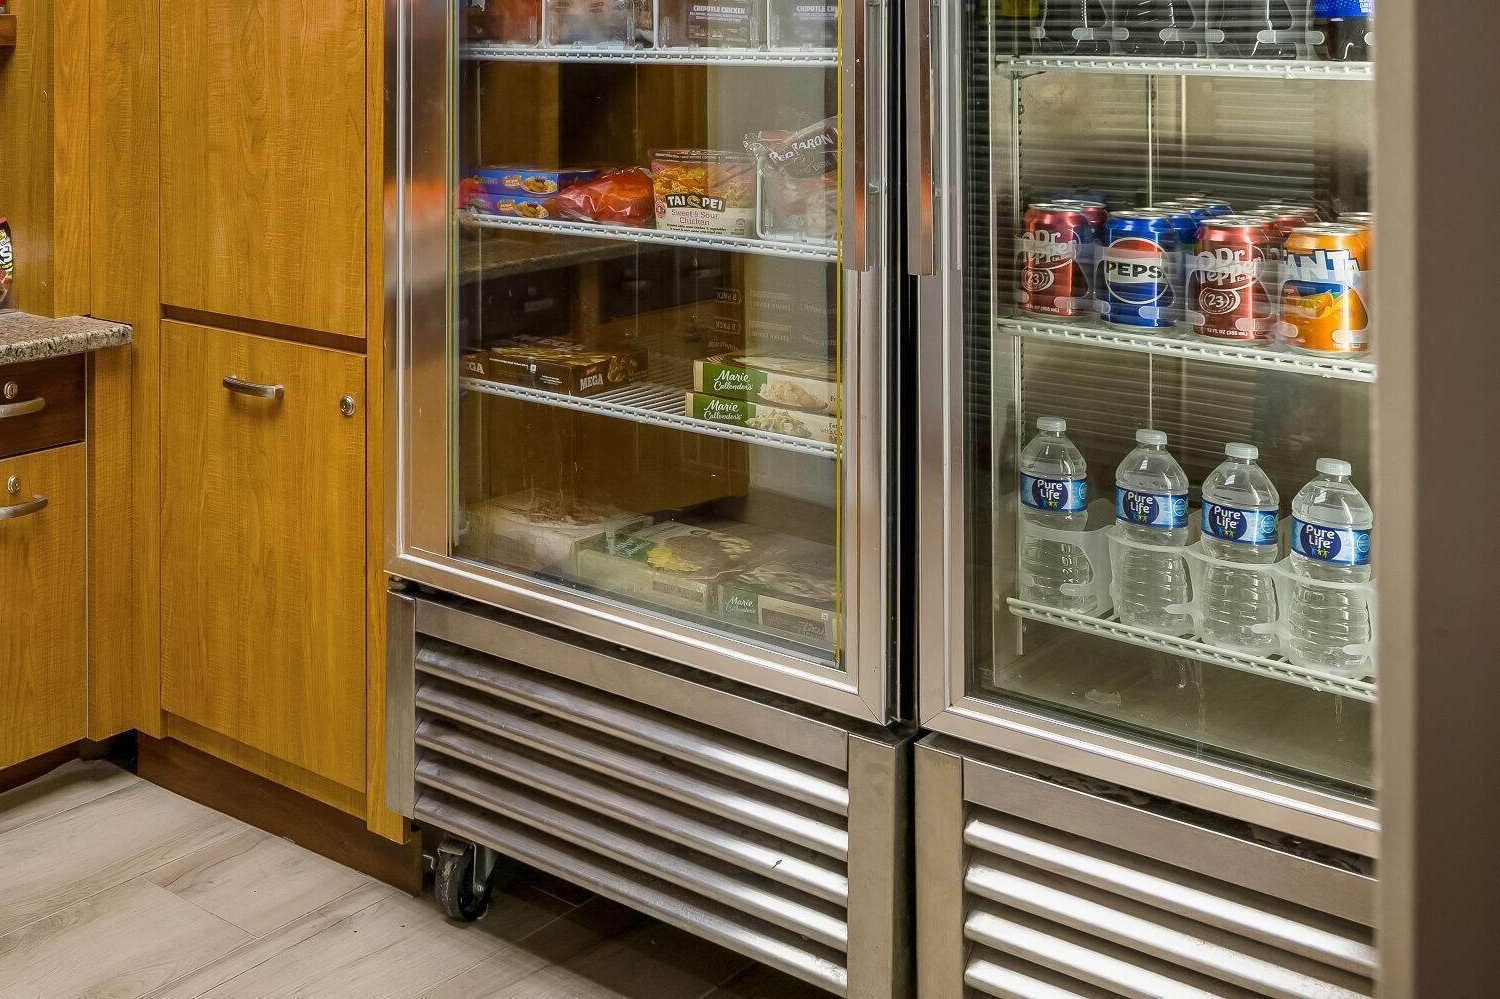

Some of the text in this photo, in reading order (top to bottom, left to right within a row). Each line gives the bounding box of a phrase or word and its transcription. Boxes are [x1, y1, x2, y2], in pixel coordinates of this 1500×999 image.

[693, 5, 746, 14] CHIPOTLE CHICKEN
[796, 5, 824, 13] CHIPOTLE
[768, 133, 834, 164] RED BARON
[667, 195, 723, 210] TAI PEI
[671, 209, 693, 218] Sweet
[699, 211, 720, 219] Sour
[679, 216, 710, 226] Chicken
[1035, 229, 1061, 245] Dr
[1214, 247, 1246, 265] Dr
[1027, 272, 1040, 285] 23
[1207, 293, 1225, 308] 23
[580, 373, 604, 391] MEGA
[714, 369, 750, 382] Marie
[713, 381, 754, 391] Callender's
[703, 399, 740, 412] Marie
[703, 411, 743, 420] Callender's
[1037, 479, 1063, 493] Pure
[1040, 489, 1062, 501] Life
[1127, 491, 1154, 505] Pure
[1130, 501, 1152, 515] Life
[1213, 505, 1241, 520] Pure
[1216, 514, 1239, 529] Life
[1305, 524, 1336, 541] Pure
[1308, 536, 1333, 549] Life
[726, 596, 754, 607] Marie
